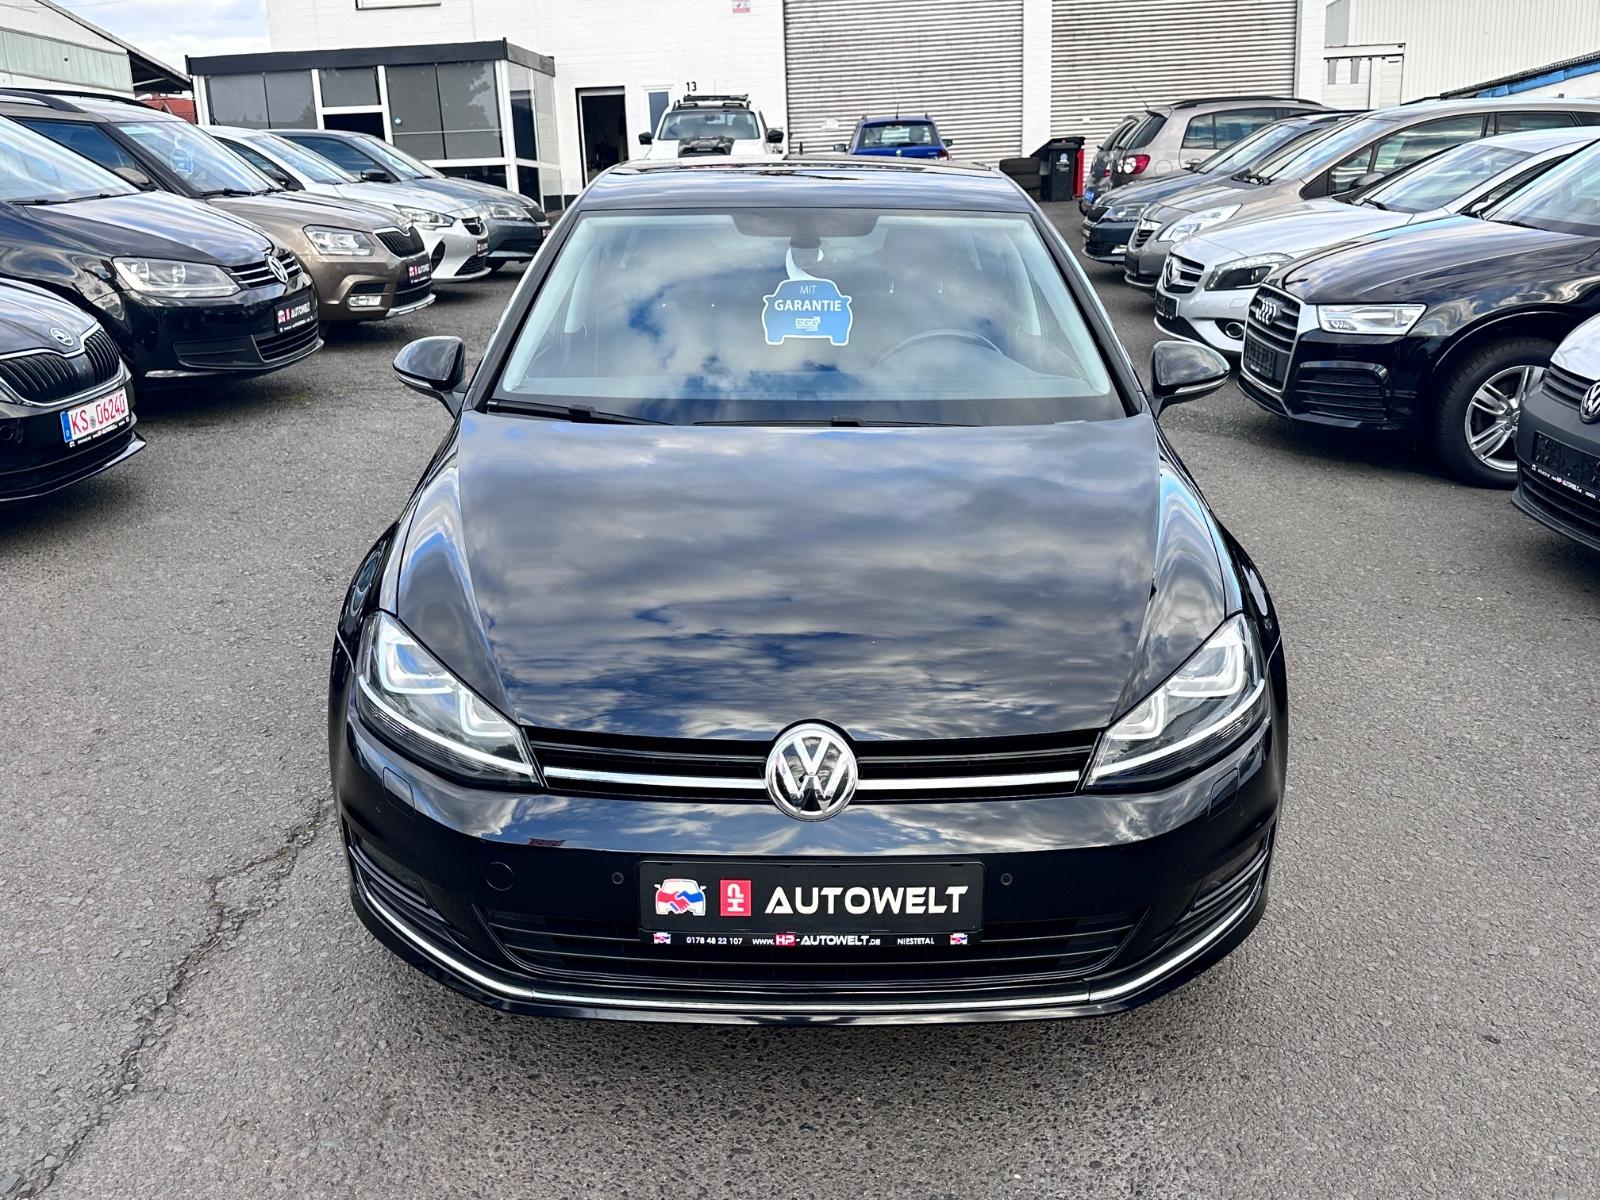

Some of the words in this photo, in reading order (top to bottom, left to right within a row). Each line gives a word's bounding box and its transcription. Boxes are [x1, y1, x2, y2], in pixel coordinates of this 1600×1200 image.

[686, 81, 697, 92] 13
[800, 285, 817, 295] MIT
[774, 299, 842, 312] GARANTIE
[70, 409, 89, 436] KS
[95, 393, 126, 425] 06240
[727, 883, 744, 912] HP
[764, 886, 969, 915] AUTOWELT
[686, 936, 705, 945] 0178
[706, 937, 717, 945] 48
[717, 937, 728, 945] 22
[730, 937, 743, 945] 107
[897, 937, 935, 945] NIESTETAL
